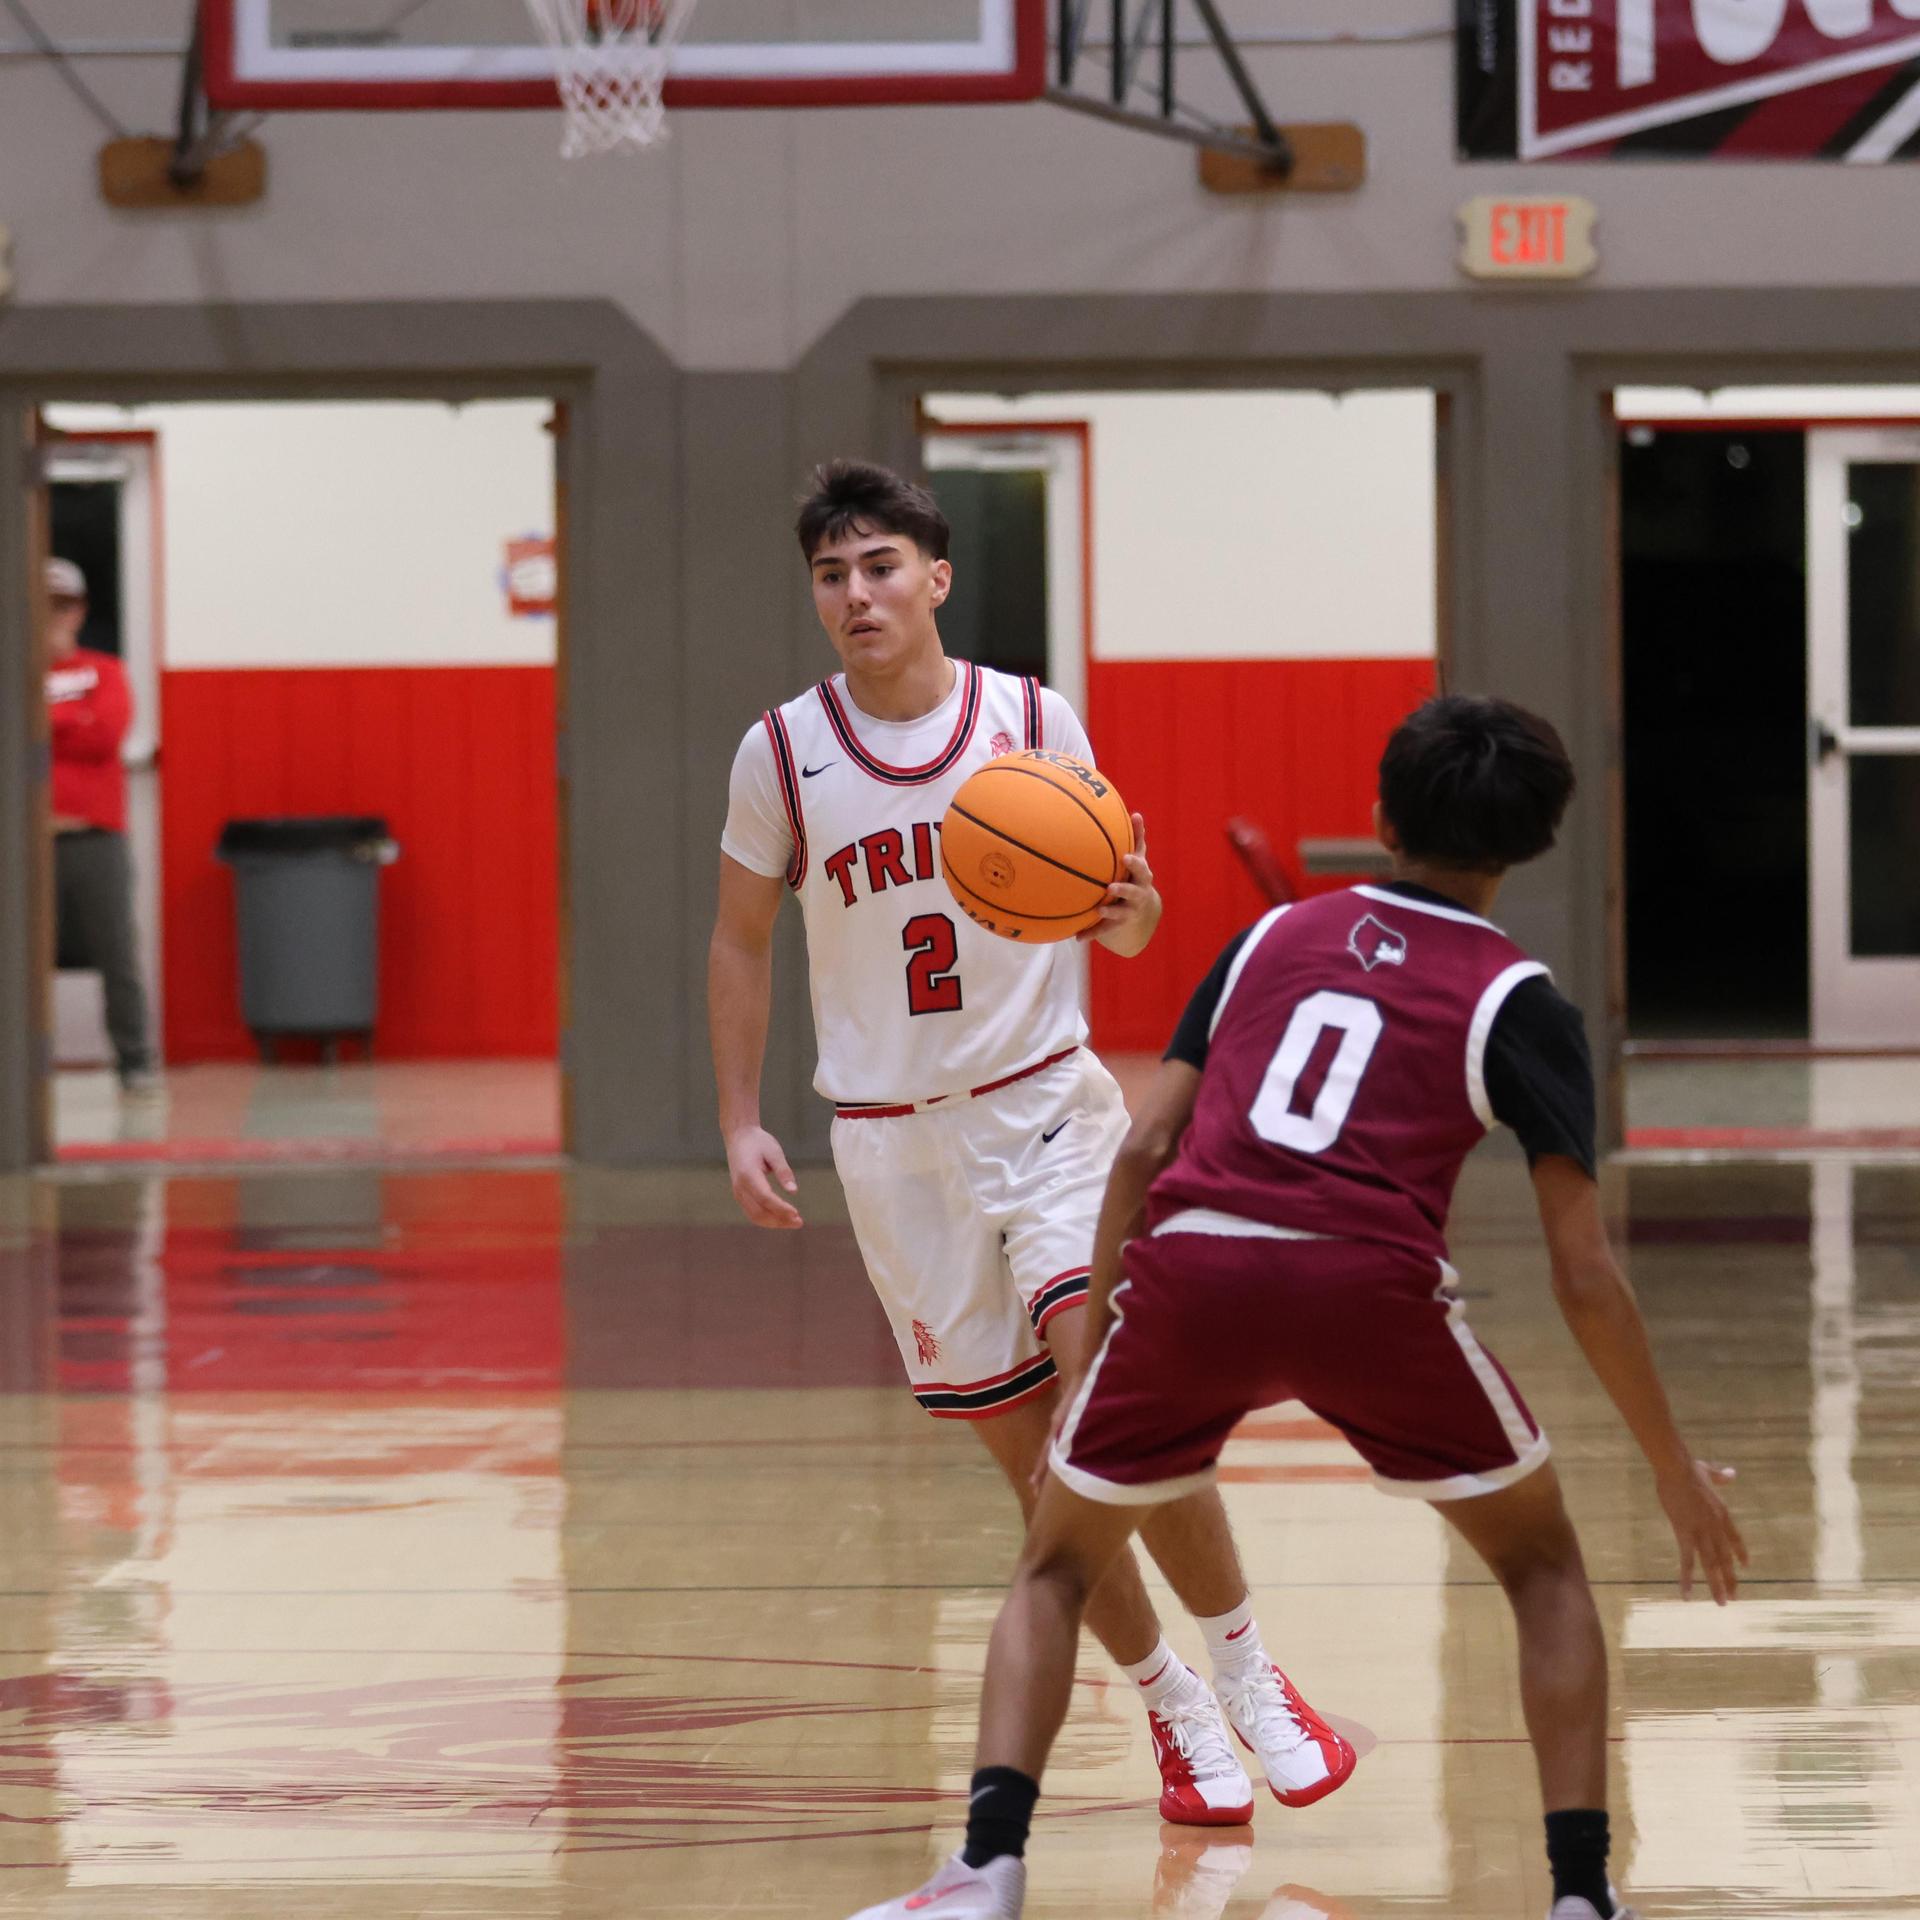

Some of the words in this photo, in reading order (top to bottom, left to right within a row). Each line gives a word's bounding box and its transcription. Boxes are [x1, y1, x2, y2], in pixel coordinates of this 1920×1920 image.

[1490, 204, 1569, 265] EXIT
[1021, 750, 1108, 799] NCAA
[824, 822, 944, 908] TRI
[902, 912, 963, 1016] 2
[1248, 989, 1384, 1155] 0
